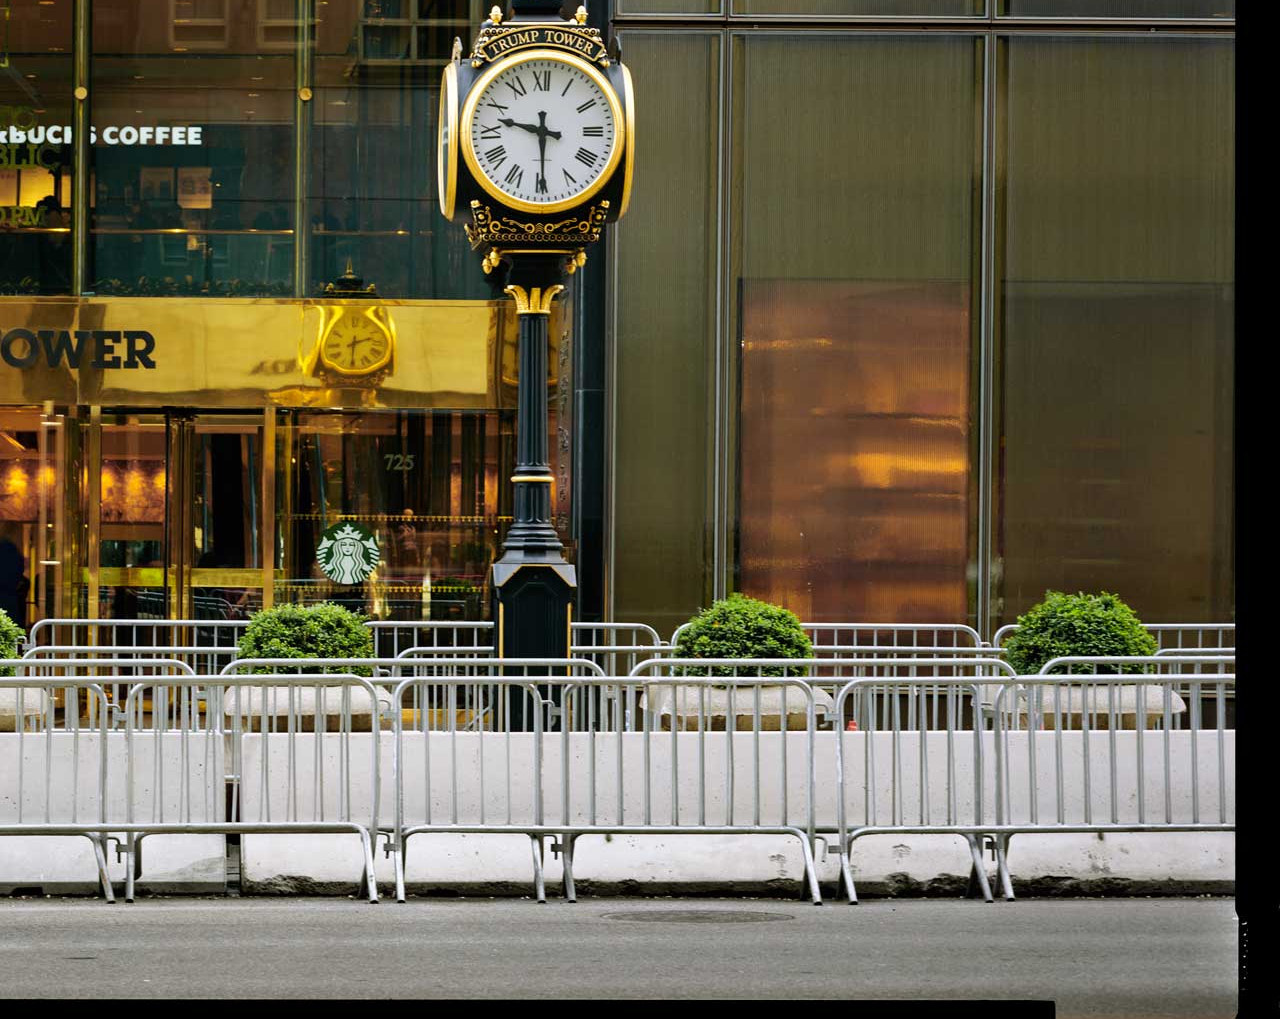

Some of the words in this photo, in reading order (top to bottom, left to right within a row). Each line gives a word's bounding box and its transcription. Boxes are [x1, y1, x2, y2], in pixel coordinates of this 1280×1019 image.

[488, 30, 539, 55] TRUMP
[544, 30, 594, 55] TOWER
[532, 69, 551, 92] XII
[102, 126, 202, 145] COFFEE
[383, 453, 416, 470] 725
